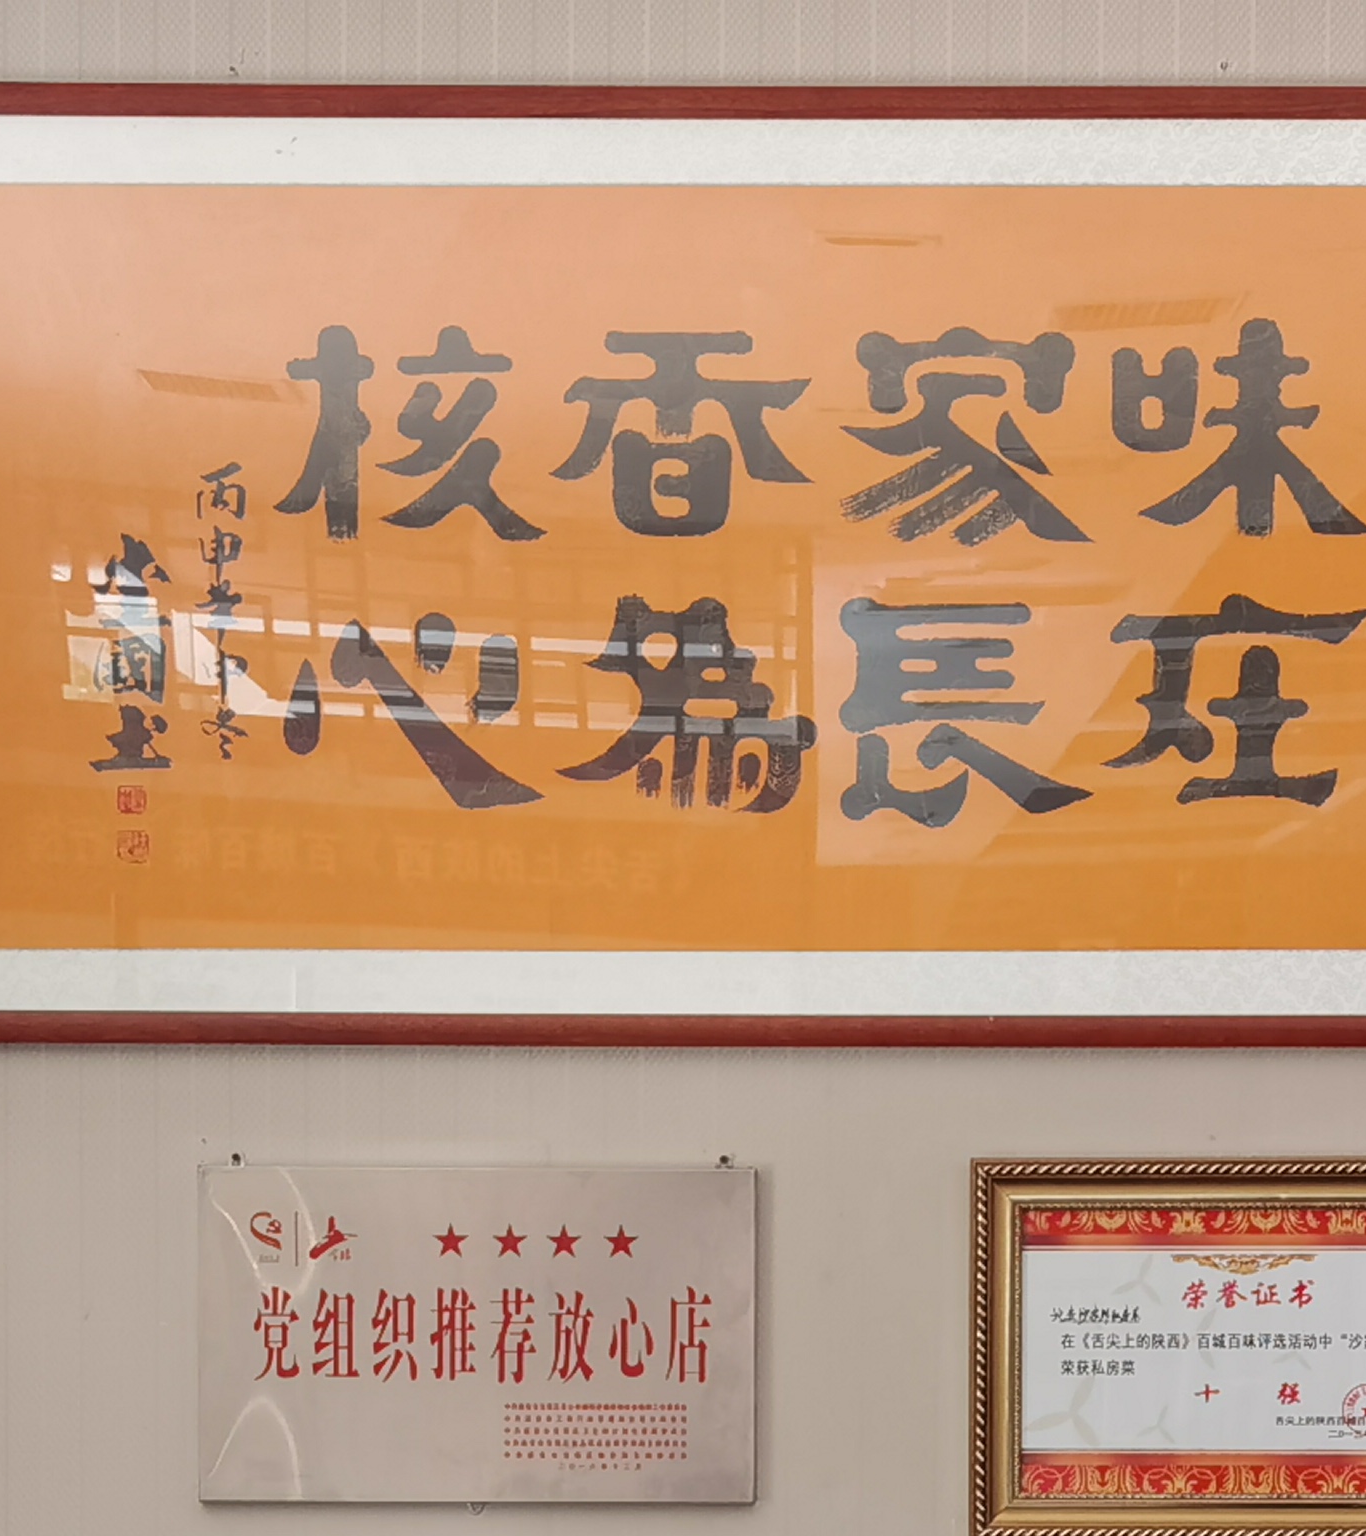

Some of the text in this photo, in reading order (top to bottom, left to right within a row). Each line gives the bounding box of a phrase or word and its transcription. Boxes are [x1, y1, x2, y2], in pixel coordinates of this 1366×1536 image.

[1181, 1279, 1317, 1310] 荣誉证书
[253, 1286, 712, 1385] 党组织推荐放心店
[1061, 1360, 1136, 1376] 荣获私房菜
